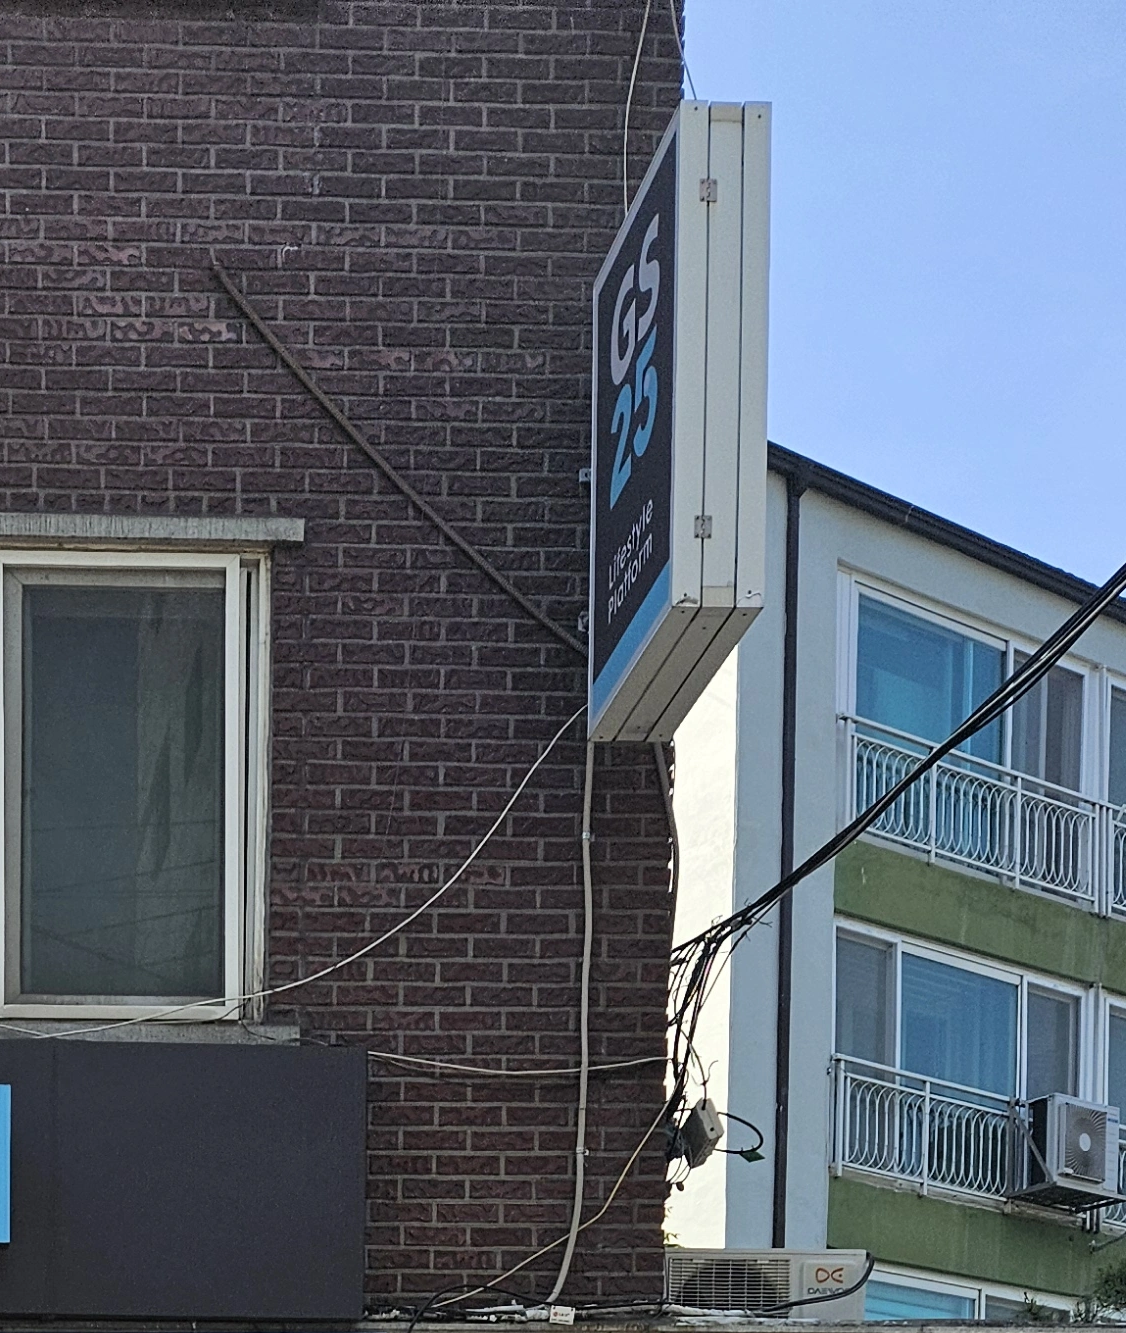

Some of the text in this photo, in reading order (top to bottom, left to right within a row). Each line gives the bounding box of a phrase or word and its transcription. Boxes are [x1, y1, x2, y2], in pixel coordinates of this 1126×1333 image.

[611, 213, 660, 386] GS
[609, 324, 658, 511] 25
[608, 499, 653, 590] Lifestyle
[608, 533, 653, 624] Platform
